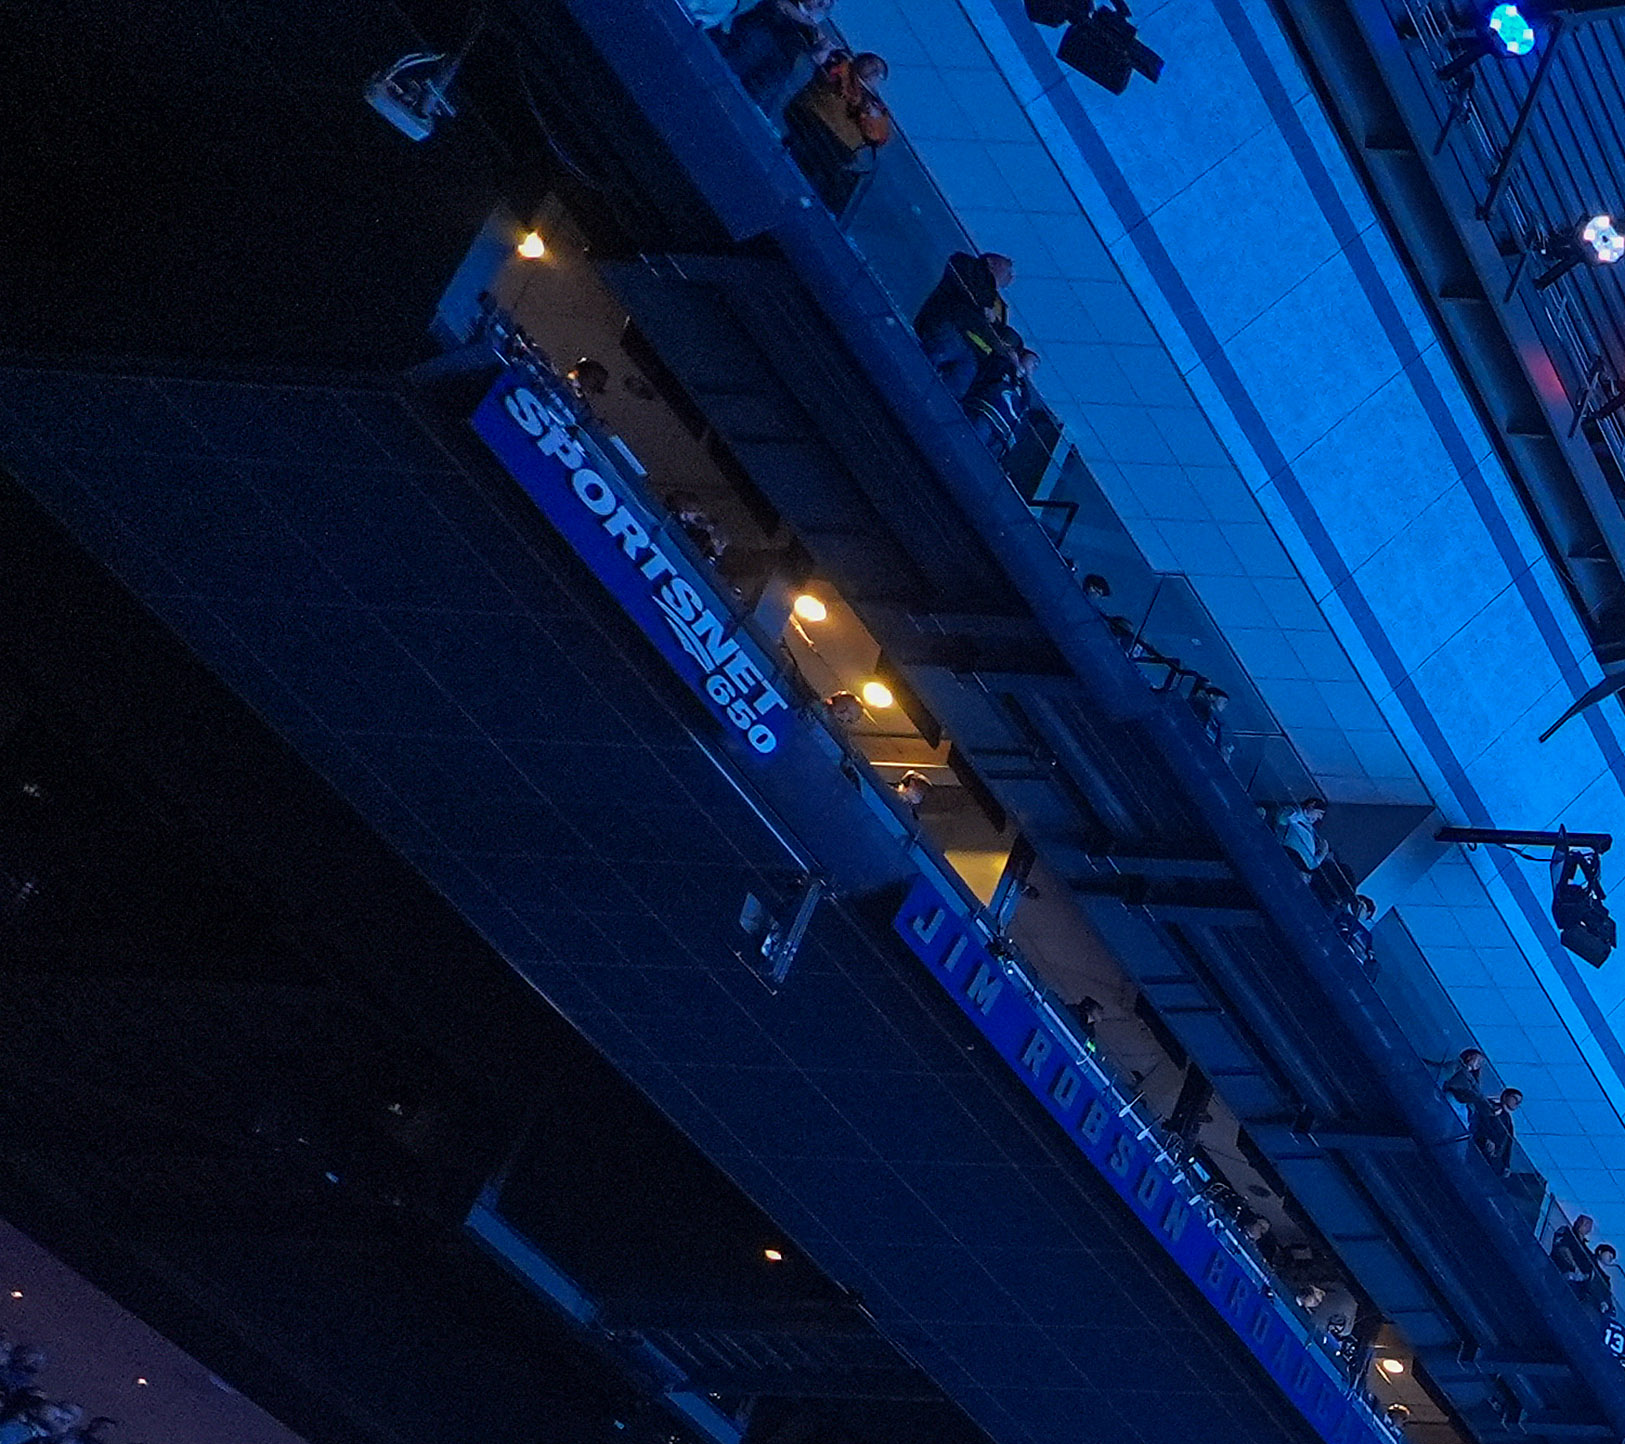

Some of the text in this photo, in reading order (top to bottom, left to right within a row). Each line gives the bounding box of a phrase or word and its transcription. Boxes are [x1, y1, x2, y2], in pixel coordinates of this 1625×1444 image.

[503, 385, 789, 757] SPORTSNET 650
[912, 904, 1006, 1016] JIM
[1021, 1028, 1192, 1243] ROBSON
